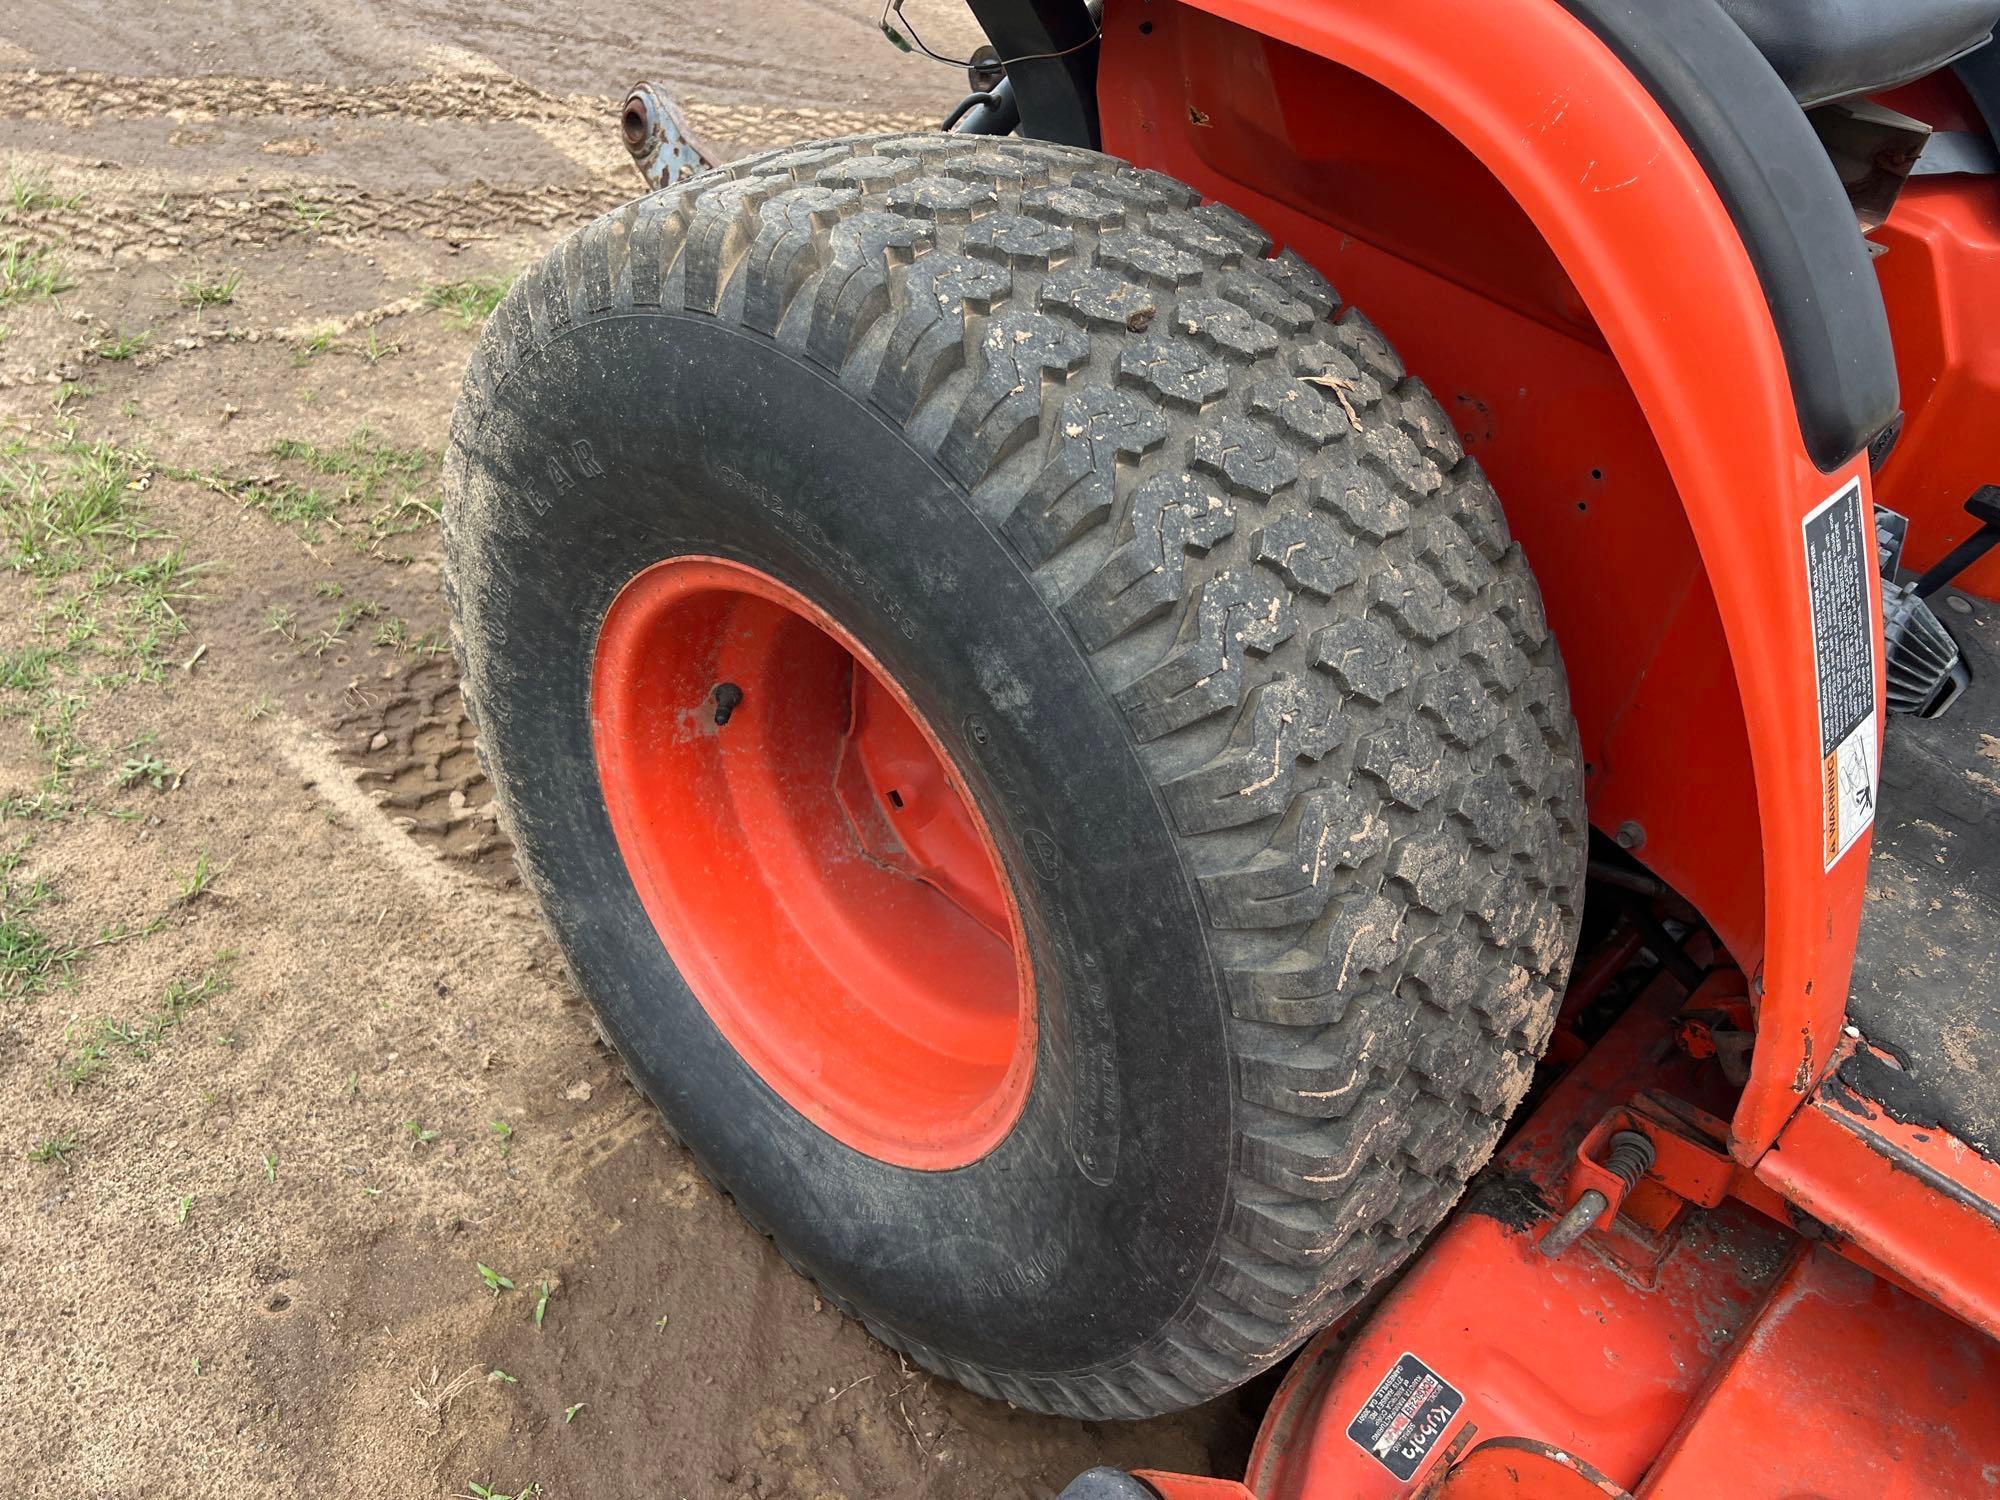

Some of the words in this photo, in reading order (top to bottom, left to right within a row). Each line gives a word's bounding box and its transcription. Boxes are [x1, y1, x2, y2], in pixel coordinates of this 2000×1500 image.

[1827, 755, 1836, 836] WARNING
[1402, 1378, 1410, 1386] of
[1426, 1383, 1443, 1404] MODEL
[1368, 1398, 1378, 1408] GA
[1375, 1387, 1394, 1410] RAMSEY
[1385, 1385, 1405, 1410] AMERICA
[1404, 1376, 1434, 1414] RCK60-24B
[1370, 1396, 1405, 1441] MANUFACTURING
[1398, 1421, 1415, 1442] SERIAL
[1401, 1405, 1451, 1459] Kubota
